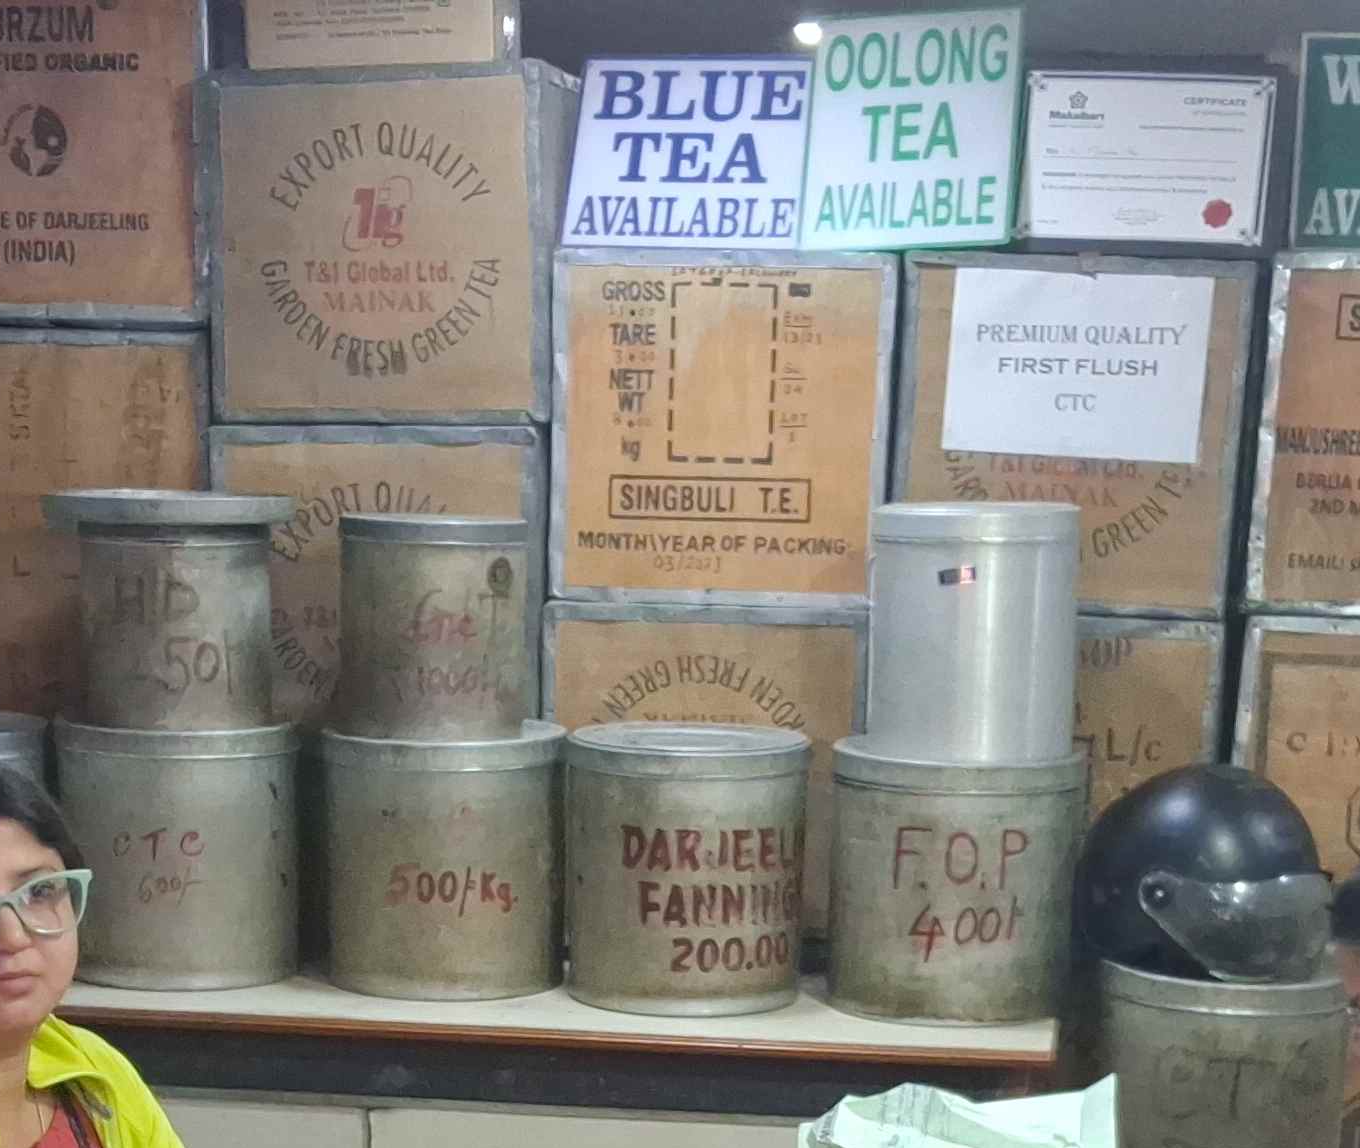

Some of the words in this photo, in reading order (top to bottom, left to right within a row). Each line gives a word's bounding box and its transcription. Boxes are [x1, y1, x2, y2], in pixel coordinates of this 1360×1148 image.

[43, 51, 139, 72] ORGANIC
[825, 22, 1009, 92] OOLONG
[593, 68, 805, 122] BLUE
[861, 102, 958, 162] TEA
[270, 122, 365, 212] EXPORT
[376, 121, 491, 201] QUALITY
[613, 132, 768, 184] TEA
[815, 175, 997, 232] AVAILABLE
[16, 210, 36, 229] OF
[42, 209, 150, 232] DARJEELING
[571, 195, 796, 240] AVAILABLE
[2, 239, 75, 266] (INDIA)
[347, 261, 408, 284] Global
[416, 261, 455, 284] Ltd.
[602, 280, 665, 302] GROSS
[260, 260, 328, 351] GARDEN
[331, 333, 407, 377] FRESH
[412, 306, 482, 364] GREEN
[466, 255, 501, 306] TEA
[609, 323, 657, 346] TARE
[976, 324, 1077, 345] PREMIUM
[1084, 323, 1188, 346] QUALITY
[609, 369, 655, 391] NETT
[998, 358, 1070, 376] FIRST
[1075, 358, 1158, 376] FLUSH
[618, 391, 644, 413] WT
[1054, 394, 1097, 412] CTC
[621, 437, 641, 462] kg
[620, 484, 735, 514] SINGBULI
[760, 487, 800, 516] T.E.
[1309, 499, 1344, 515] 2ND
[272, 482, 361, 562] EXPORT
[1091, 494, 1169, 558] GREEN
[721, 535, 747, 554] OF
[602, 660, 671, 719] GREEN
[669, 933, 789, 974] 200.00
